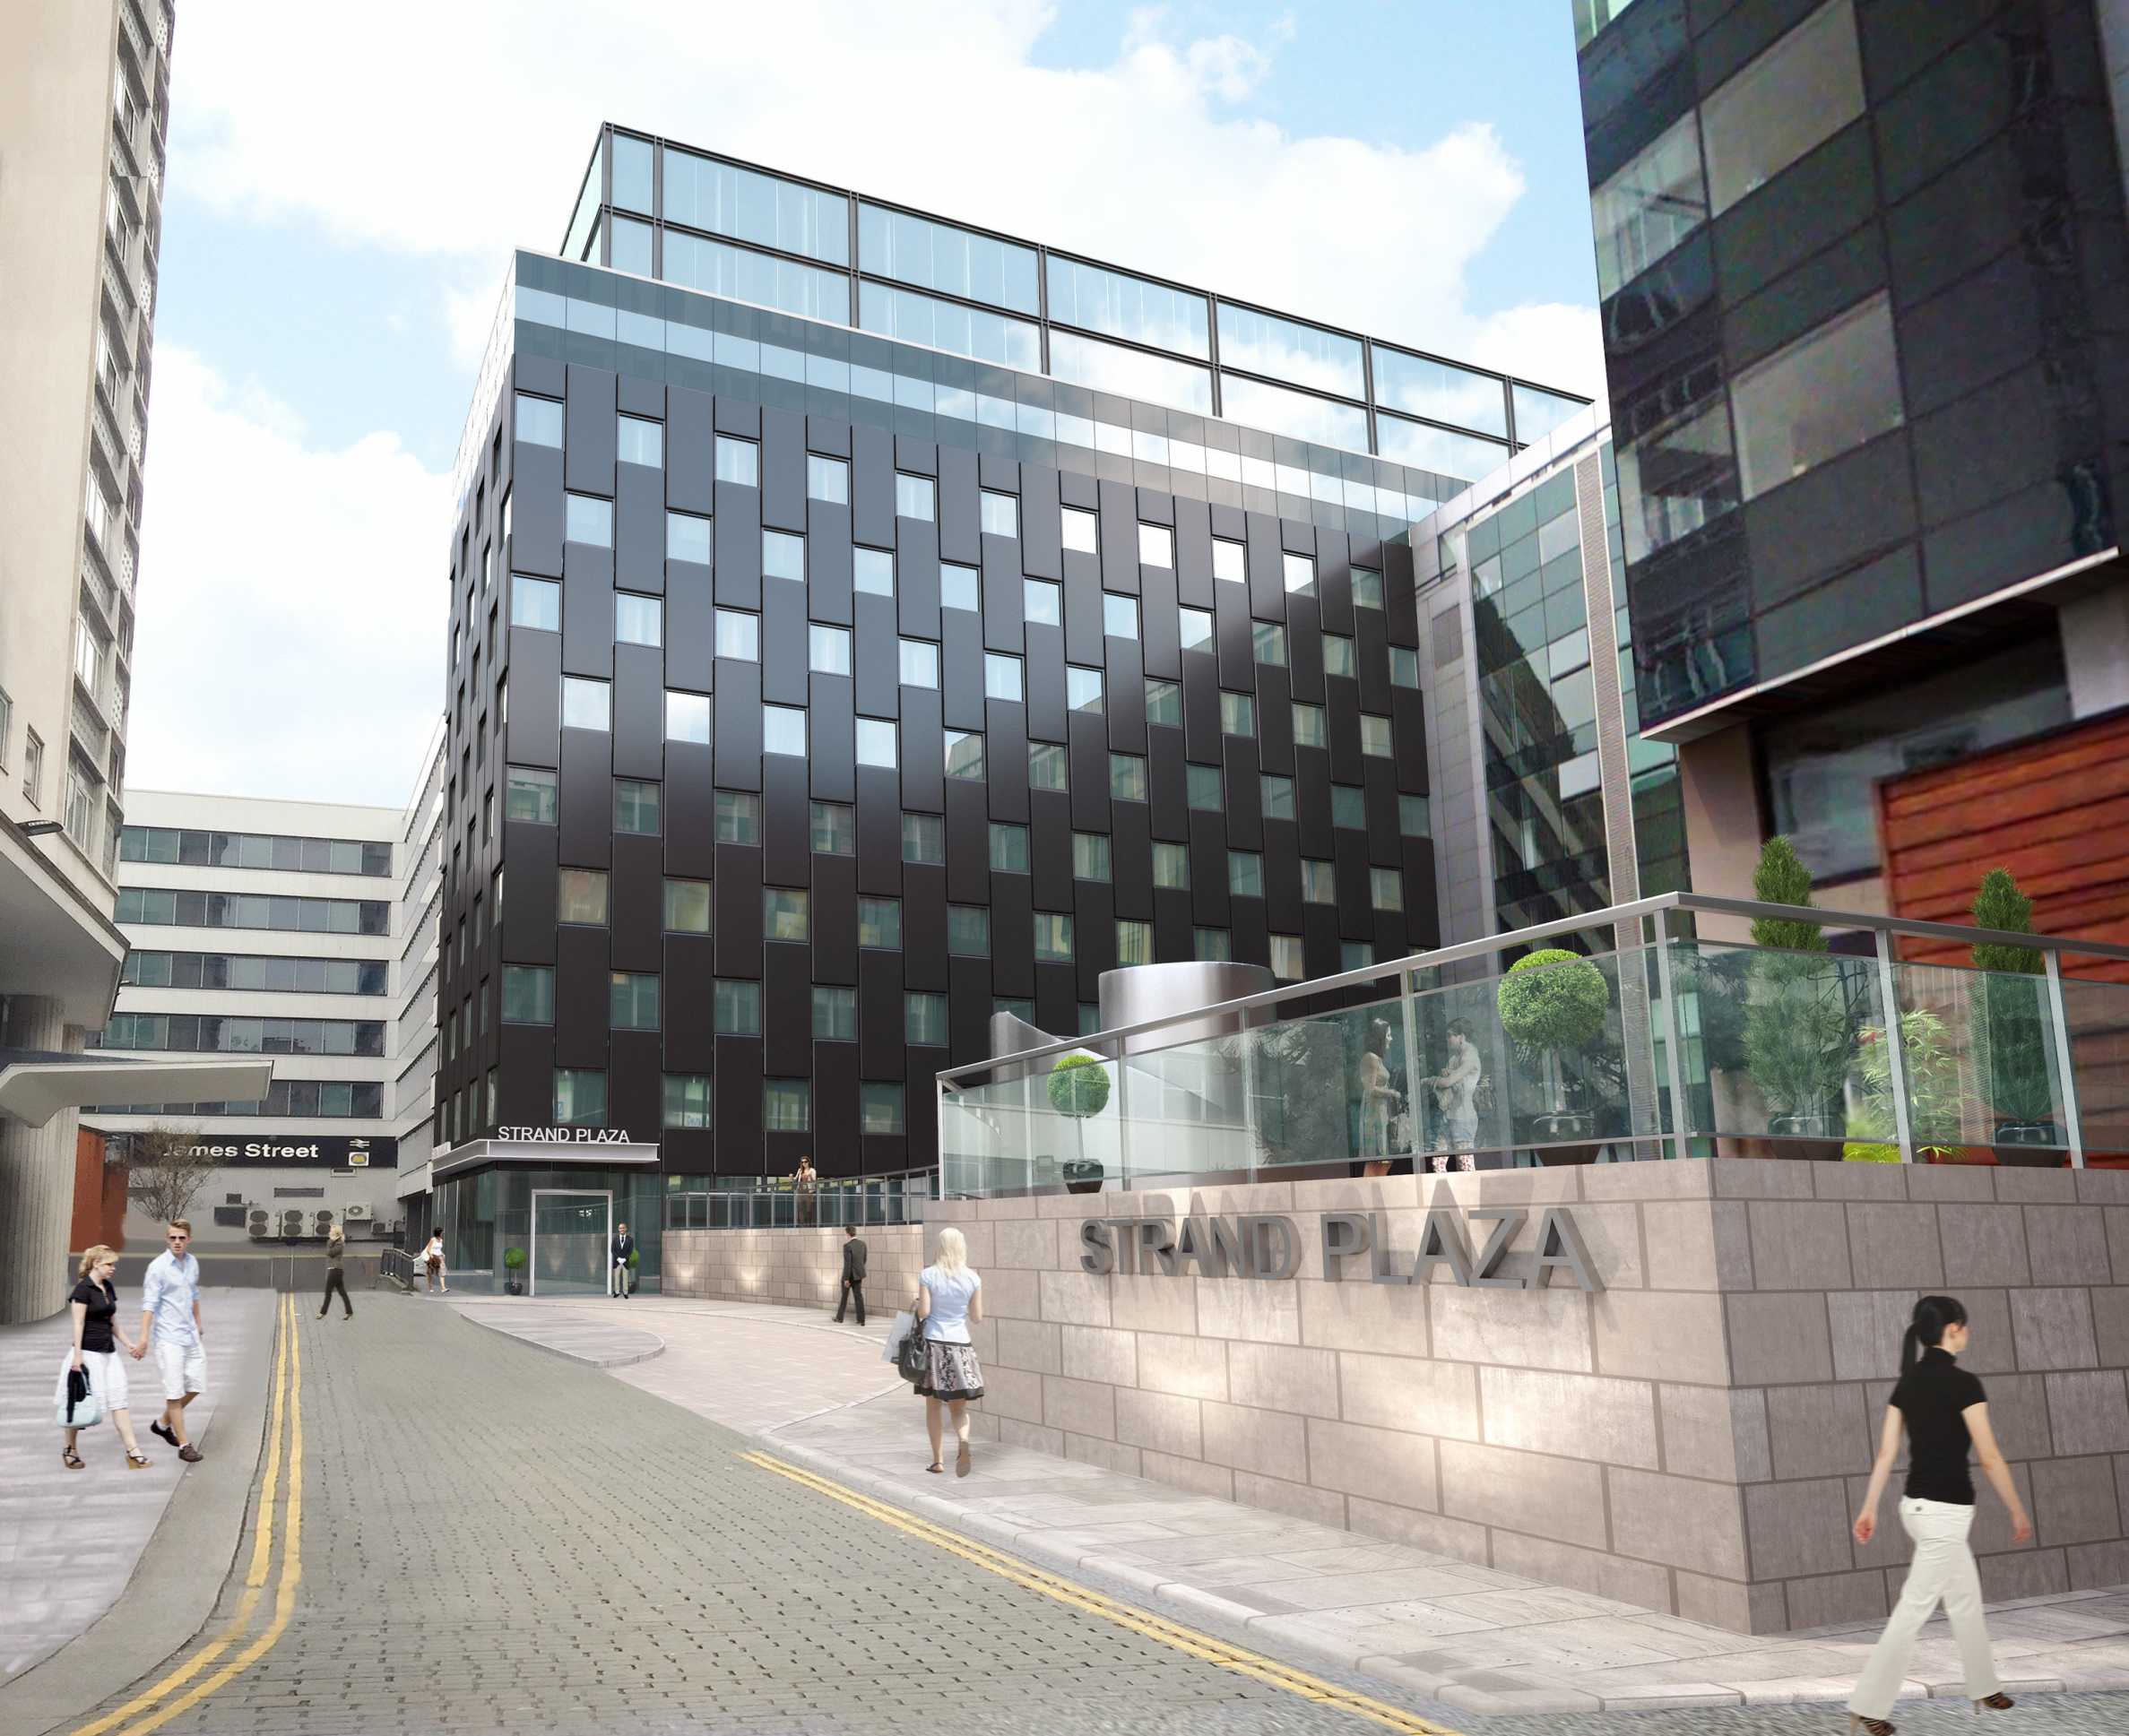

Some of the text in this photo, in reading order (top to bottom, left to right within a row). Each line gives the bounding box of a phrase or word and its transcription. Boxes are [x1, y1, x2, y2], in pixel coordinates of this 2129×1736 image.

[498, 1127, 630, 1143] STRAND PLAZA
[245, 1144, 319, 1158] Street
[1079, 1207, 1605, 1292] STRAND PLAZA
